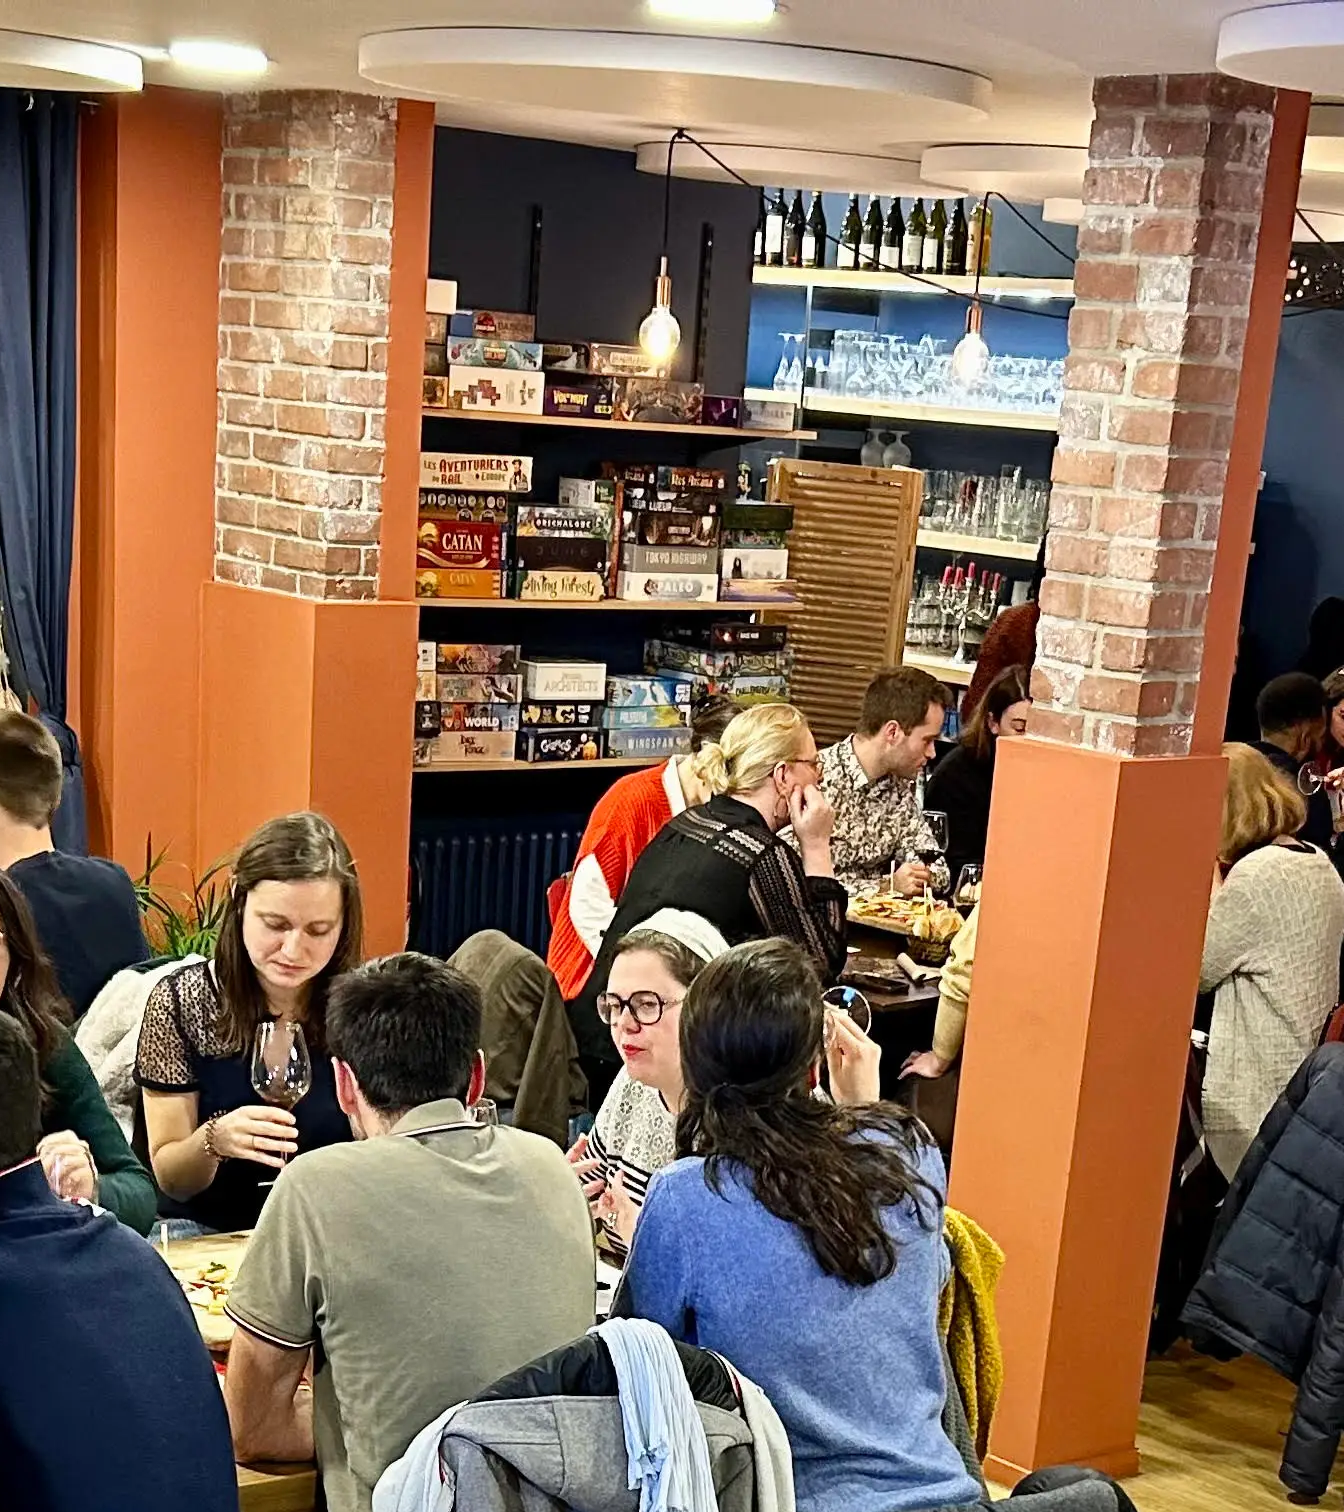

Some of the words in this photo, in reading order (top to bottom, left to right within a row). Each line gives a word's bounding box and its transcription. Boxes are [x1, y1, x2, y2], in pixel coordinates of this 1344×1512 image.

[423, 460, 436, 470] LES
[439, 459, 508, 473] AVENTURIERS
[441, 473, 463, 484] RAIL
[442, 532, 484, 551] CATAN
[645, 552, 670, 564] TOKYO
[464, 717, 500, 727] WORLD
[627, 738, 674, 750] WINGSPAN
